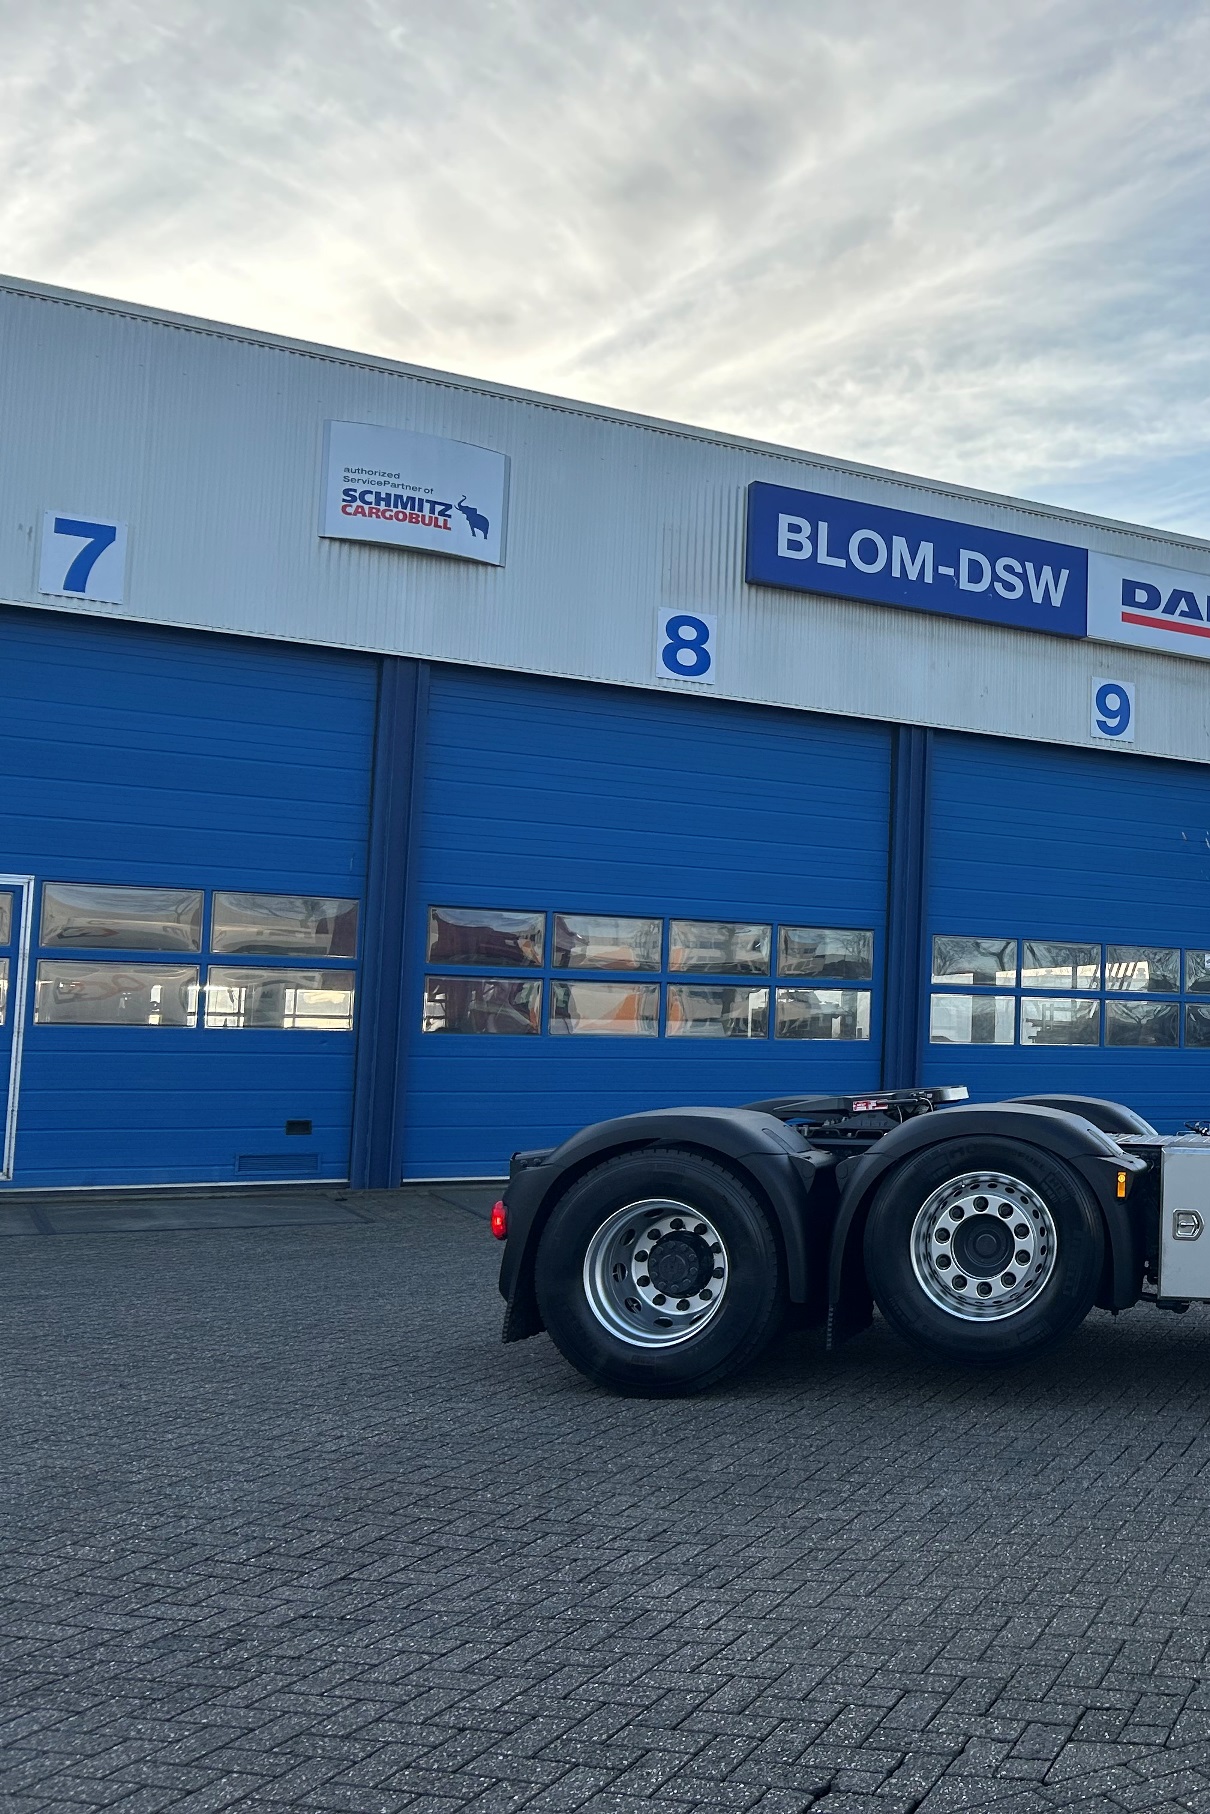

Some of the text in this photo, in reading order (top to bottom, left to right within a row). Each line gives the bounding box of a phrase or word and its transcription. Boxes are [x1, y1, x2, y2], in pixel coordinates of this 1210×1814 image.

[342, 475, 434, 495] ServicePartner of
[343, 467, 401, 480] authorized
[341, 487, 453, 519] SCHMITZ
[341, 503, 452, 531] CARGOBULL
[54, 517, 117, 594] 7
[777, 513, 1070, 608] BLOM-DSW
[661, 614, 712, 677] 8
[1095, 683, 1132, 736] 9
